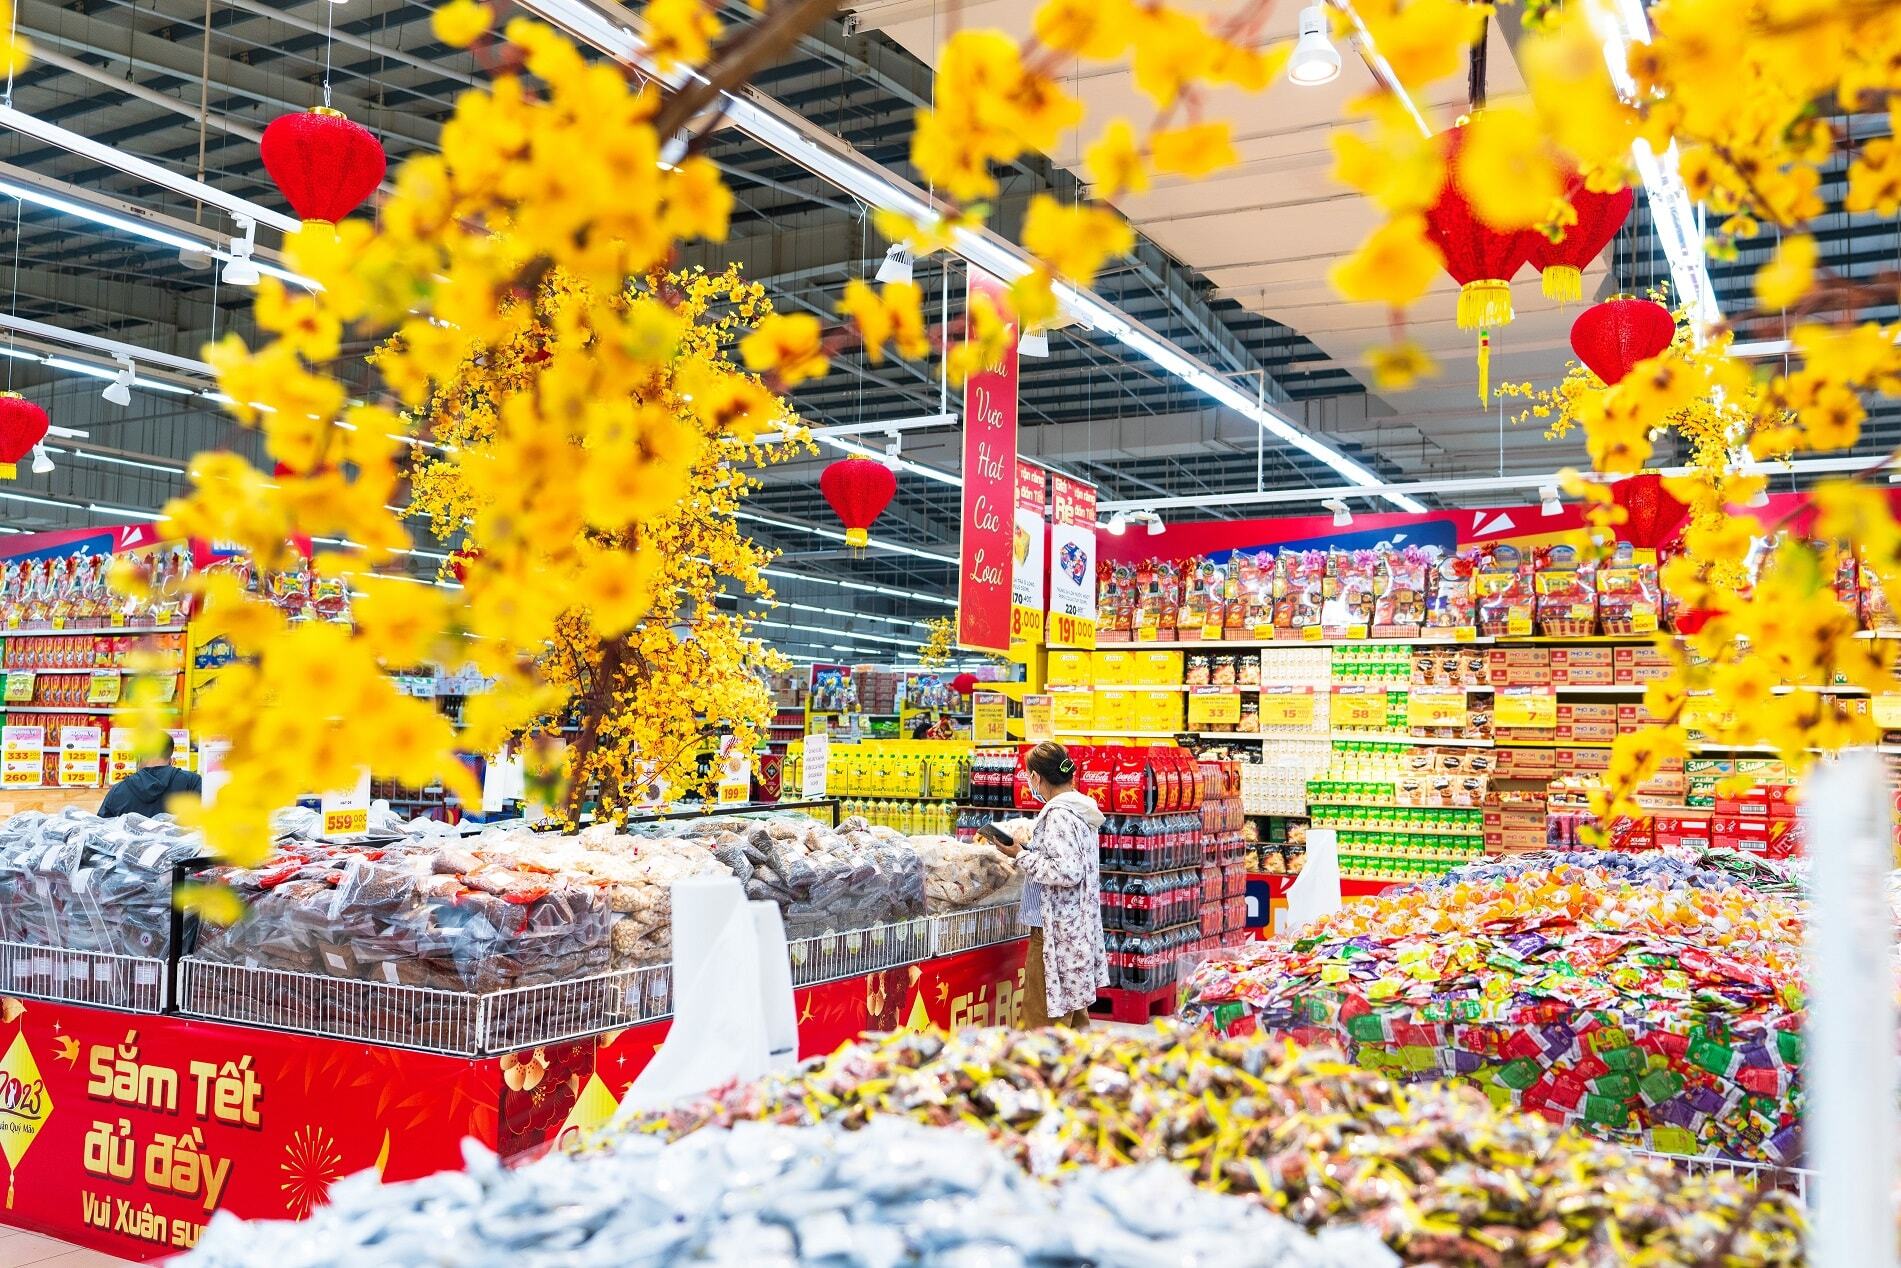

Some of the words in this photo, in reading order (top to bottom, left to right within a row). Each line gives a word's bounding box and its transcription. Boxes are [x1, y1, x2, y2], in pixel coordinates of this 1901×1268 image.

[975, 386, 1004, 431] Vực
[977, 441, 1005, 485] Hạt
[973, 495, 1000, 533] Các
[1055, 494, 1075, 526] Rẻ
[969, 548, 1004, 592] Loại
[1012, 607, 1040, 635] 8.000
[1064, 706, 1079, 715] 75
[1208, 708, 1225, 717] 33
[1282, 709, 1297, 718] 15
[1351, 709, 1369, 718] 58
[1527, 711, 1537, 721] 7
[7, 752, 29, 760] 333
[68, 752, 86, 760] 125
[5, 774, 28, 782] 260
[67, 773, 85, 781] 175
[724, 788, 739, 799] 199
[327, 814, 352, 830] 559
[87, 1028, 179, 1111] Sắm
[189, 1054, 263, 1126] Tết
[83, 1117, 136, 1180] đủ
[144, 1126, 231, 1211] đầy
[82, 1189, 112, 1230] Vui
[114, 1198, 168, 1244] Xuân
